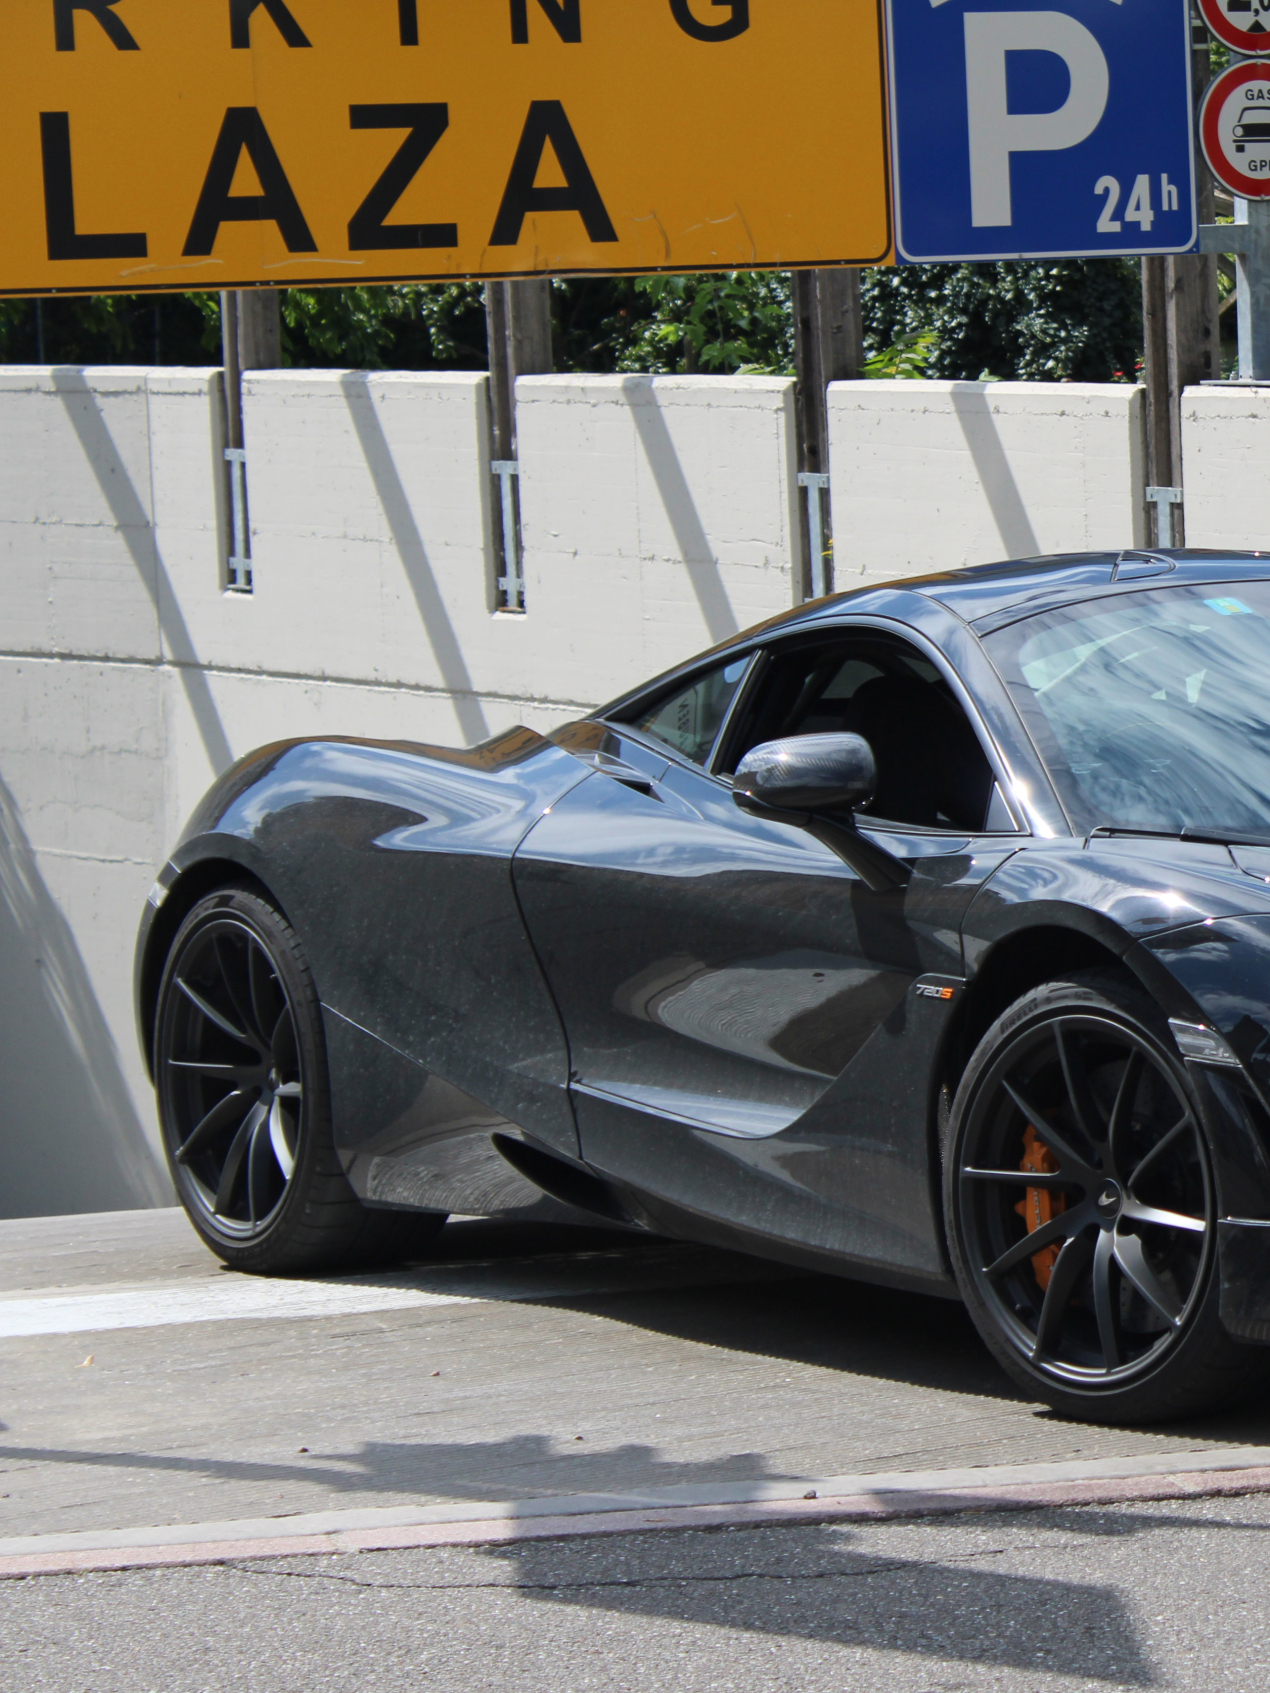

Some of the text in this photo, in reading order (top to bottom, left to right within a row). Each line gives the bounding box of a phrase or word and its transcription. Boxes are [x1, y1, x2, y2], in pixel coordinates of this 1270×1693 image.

[40, 100, 619, 260] LAZA
[963, 11, 1109, 227] P
[916, 984, 954, 999] 720S
